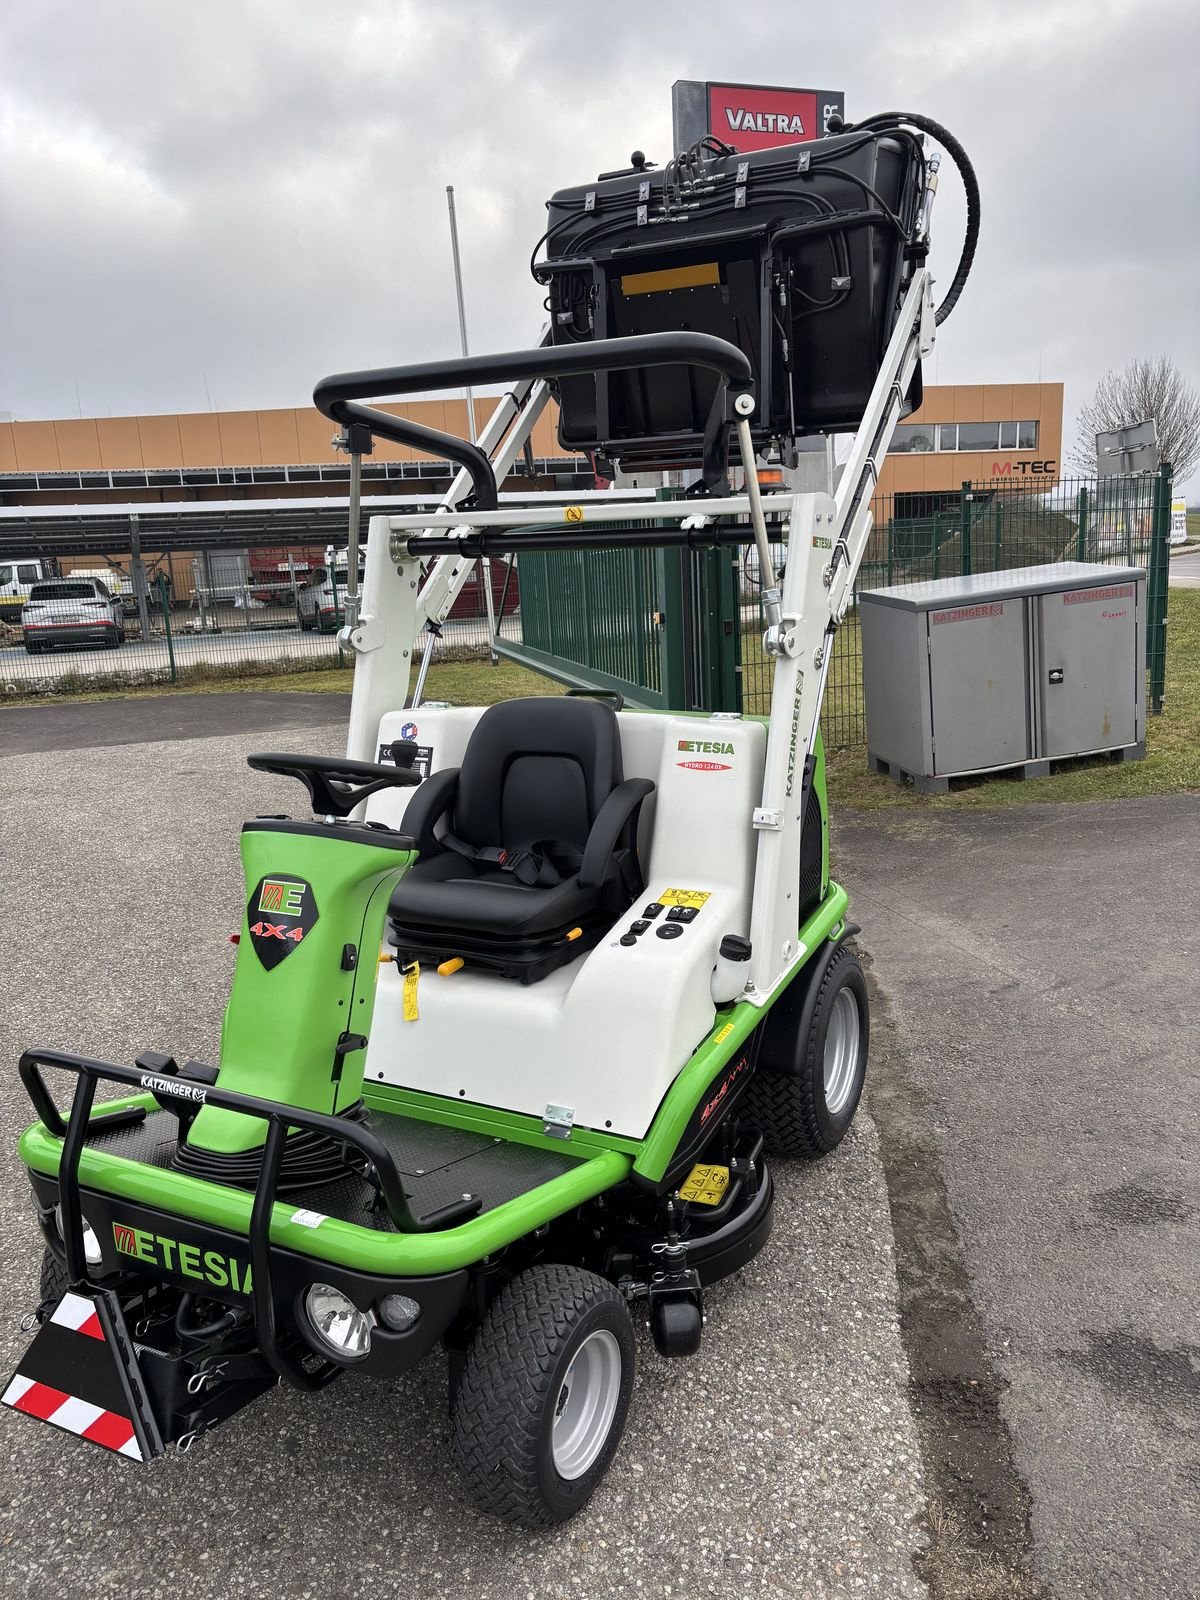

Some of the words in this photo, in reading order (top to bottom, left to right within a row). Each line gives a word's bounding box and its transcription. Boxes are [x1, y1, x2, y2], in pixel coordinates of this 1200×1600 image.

[724, 107, 805, 135] VALTRA
[992, 460, 1056, 475] M-TEC
[1063, 587, 1118, 605] KATZINGER
[932, 605, 989, 624] KATZINGER
[785, 697, 801, 797] KATZINGER
[140, 1074, 192, 1099] KATZINGER
